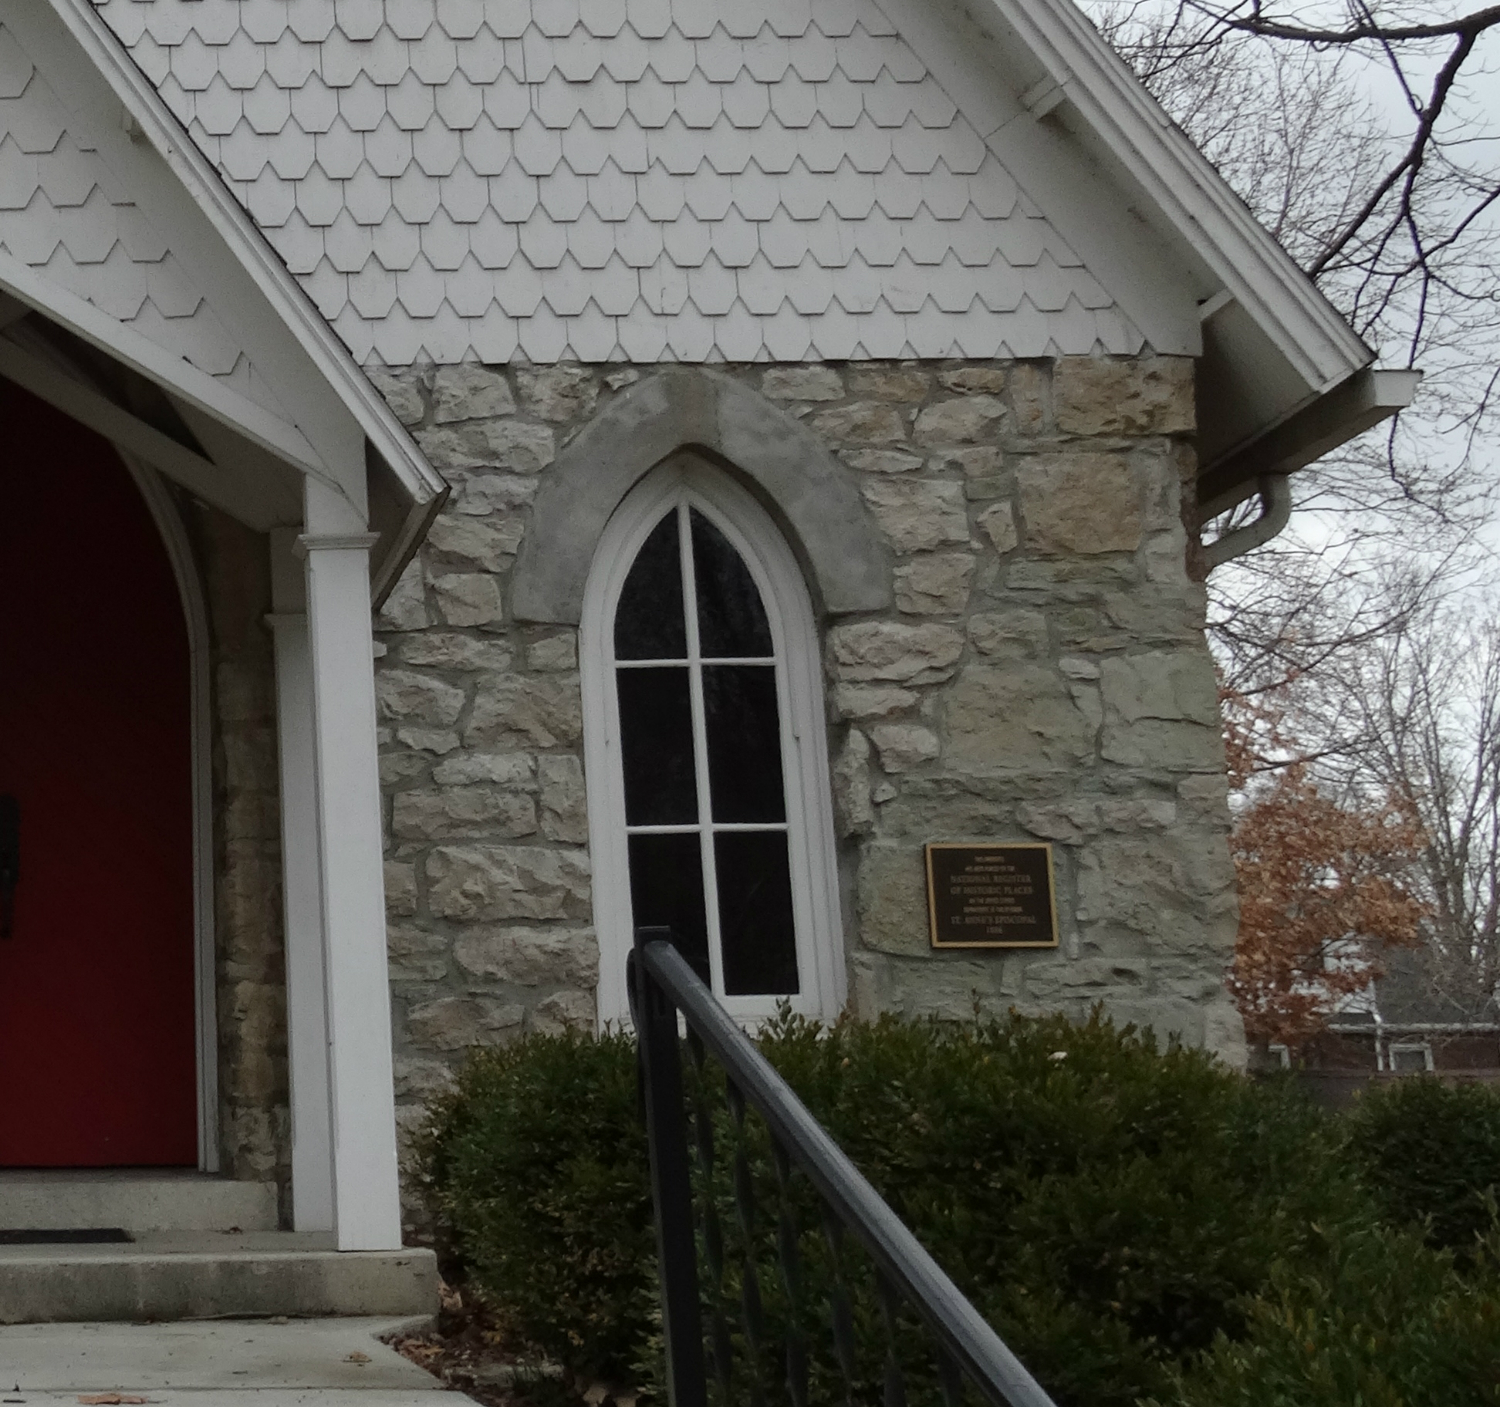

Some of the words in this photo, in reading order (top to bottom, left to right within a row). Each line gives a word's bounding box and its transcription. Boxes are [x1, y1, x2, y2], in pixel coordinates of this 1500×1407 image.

[951, 875, 991, 883] NATIONAL
[993, 875, 1031, 883] REGISTER
[951, 886, 962, 894] OF
[963, 886, 1002, 894] HISTORIC
[1004, 886, 1033, 894] PLACES
